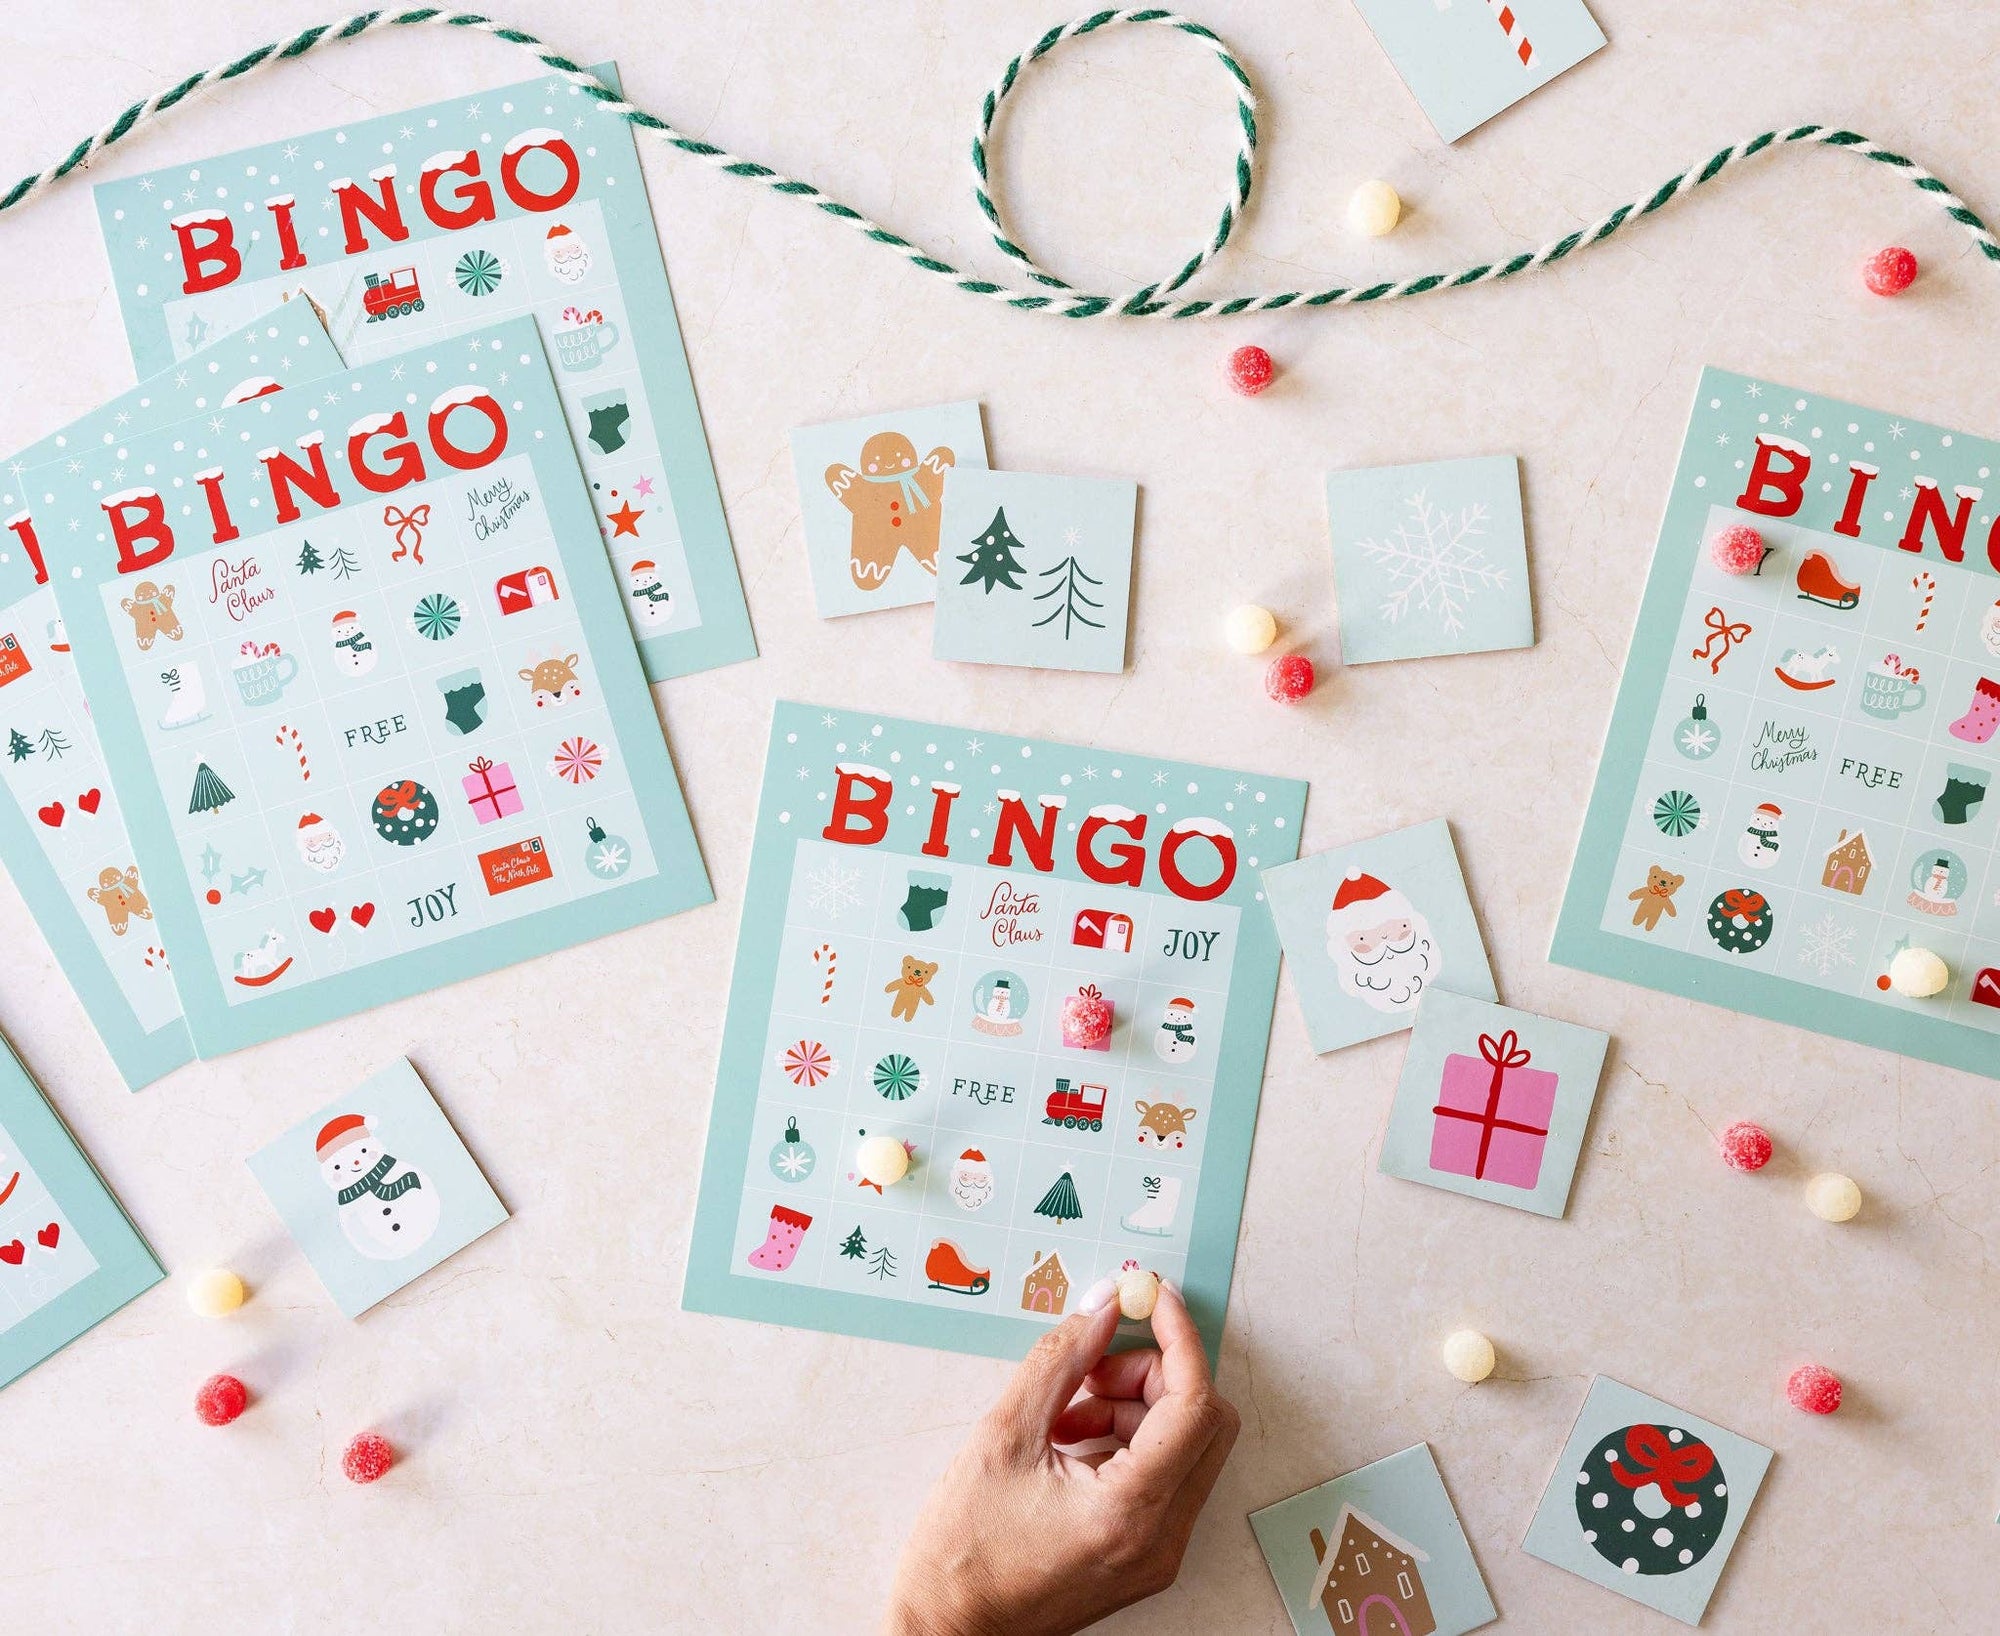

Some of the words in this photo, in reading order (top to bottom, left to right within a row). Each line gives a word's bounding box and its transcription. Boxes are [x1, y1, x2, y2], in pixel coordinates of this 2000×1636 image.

[170, 128, 580, 296] BINGO
[101, 384, 509, 576] BINGO
[467, 477, 513, 521] Merry
[475, 491, 530, 540] Christmas
[1736, 433, 2000, 575] BIN
[209, 558, 261, 603] Santa
[227, 588, 275, 621] Claus
[344, 714, 407, 748] FREE
[1753, 721, 1810, 749] Merry
[1751, 747, 1818, 773] Christmas
[1840, 758, 1903, 789] FREE
[822, 763, 1237, 902] BINGO
[492, 862, 510, 876] Santa
[407, 882, 458, 928] JOY
[980, 881, 1041, 920] Santa
[992, 918, 1044, 947] Claus
[1163, 929, 1221, 962] JOY
[952, 1078, 1016, 1106] FREE
